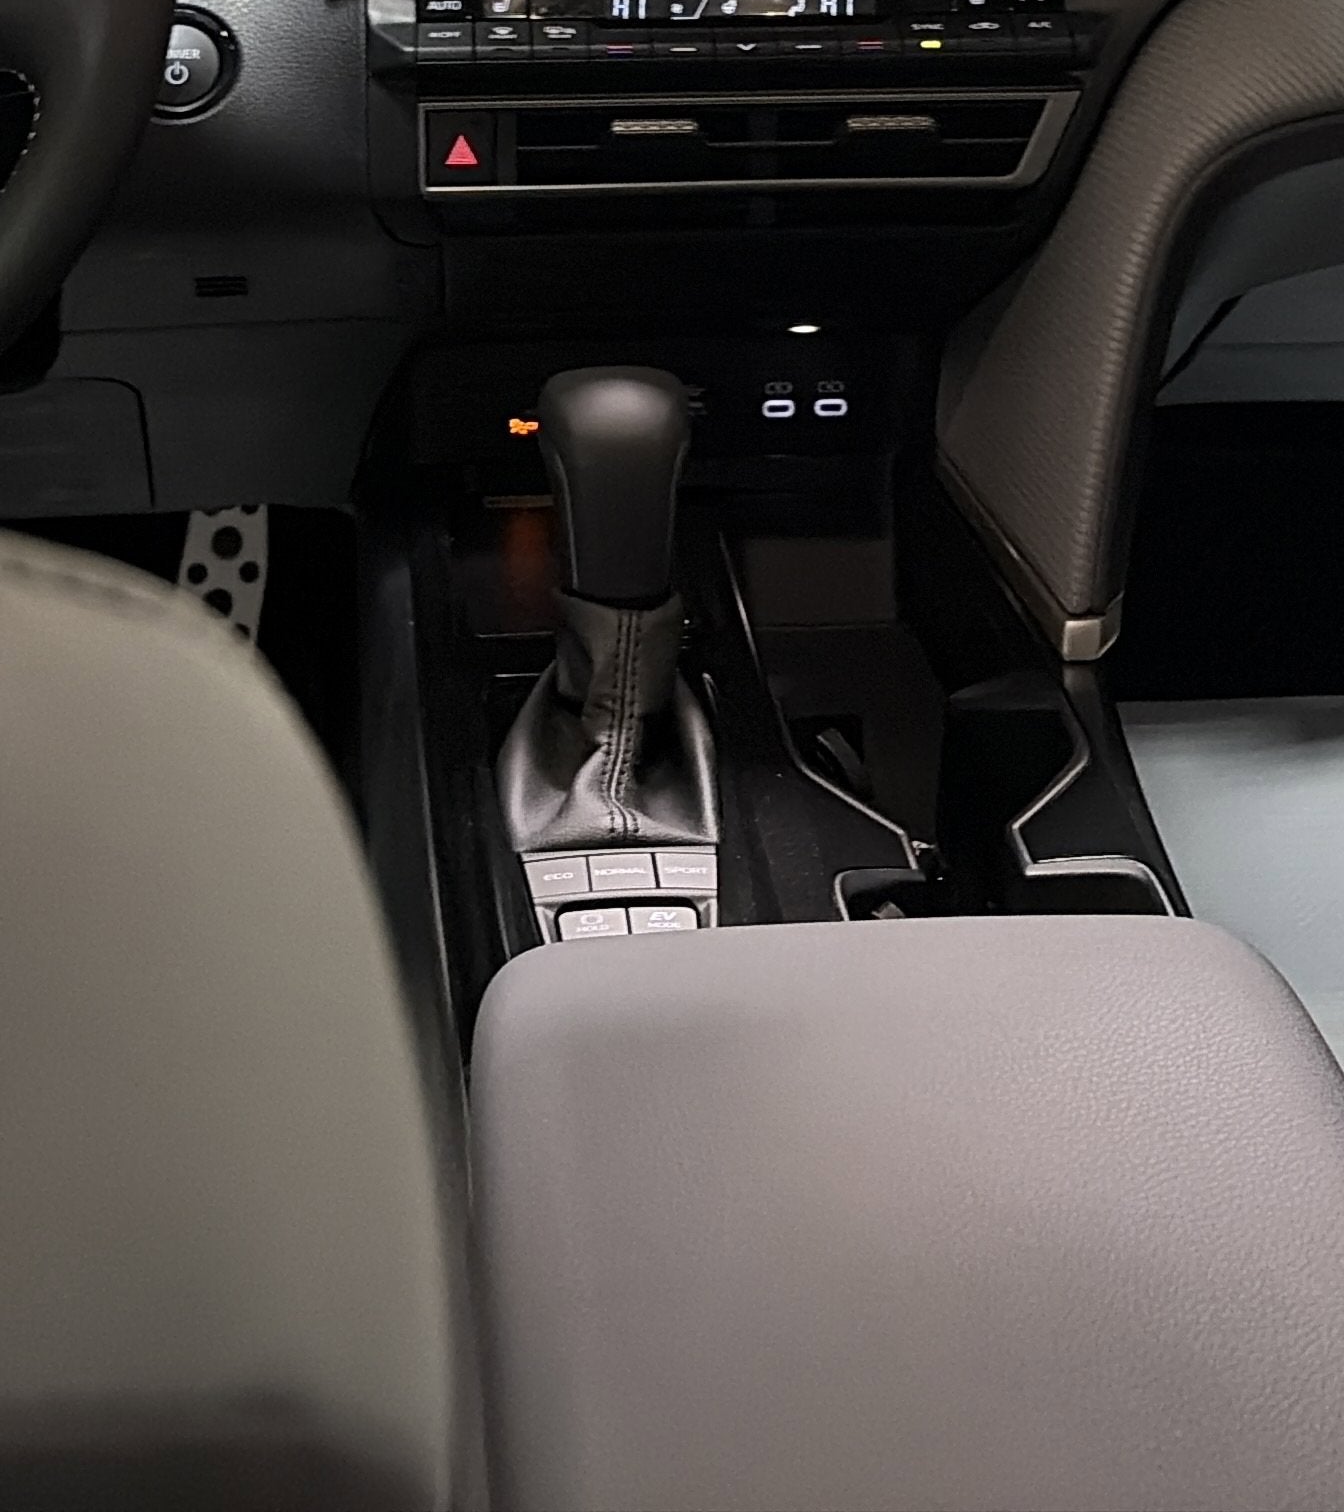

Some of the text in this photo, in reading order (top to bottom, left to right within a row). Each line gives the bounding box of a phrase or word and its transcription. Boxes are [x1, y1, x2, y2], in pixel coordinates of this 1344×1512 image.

[426, 0, 463, 11] AUTO
[593, 866, 648, 877] NORMAL
[664, 865, 709, 876] SPORT
[543, 871, 575, 882] ECO
[648, 911, 678, 922] EV
[575, 923, 610, 933] HOLD
[647, 921, 682, 929] MODE
